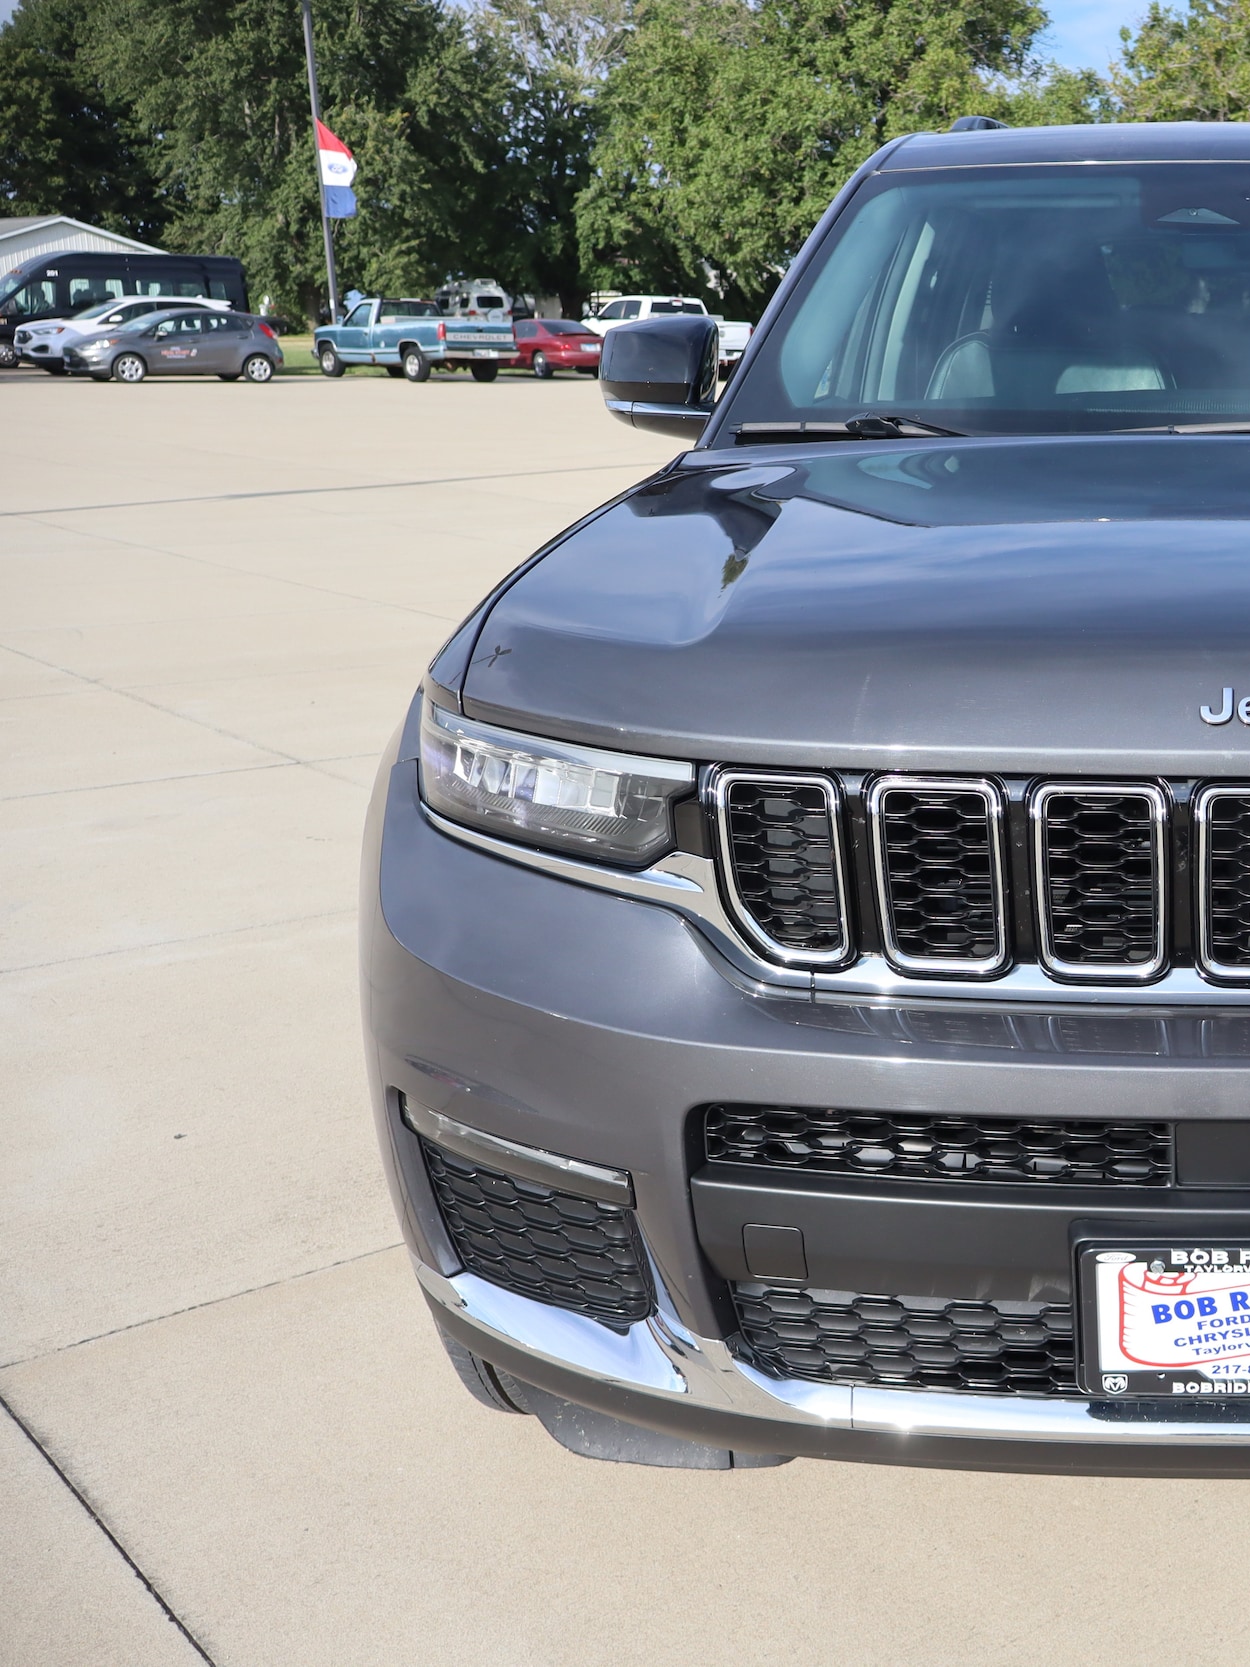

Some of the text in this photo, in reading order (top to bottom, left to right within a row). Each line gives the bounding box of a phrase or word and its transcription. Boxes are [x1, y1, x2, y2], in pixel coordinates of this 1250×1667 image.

[453, 333, 507, 341] CHEVROLET
[1170, 1248, 1229, 1265] BOB
[1151, 1296, 1218, 1324] BOB
